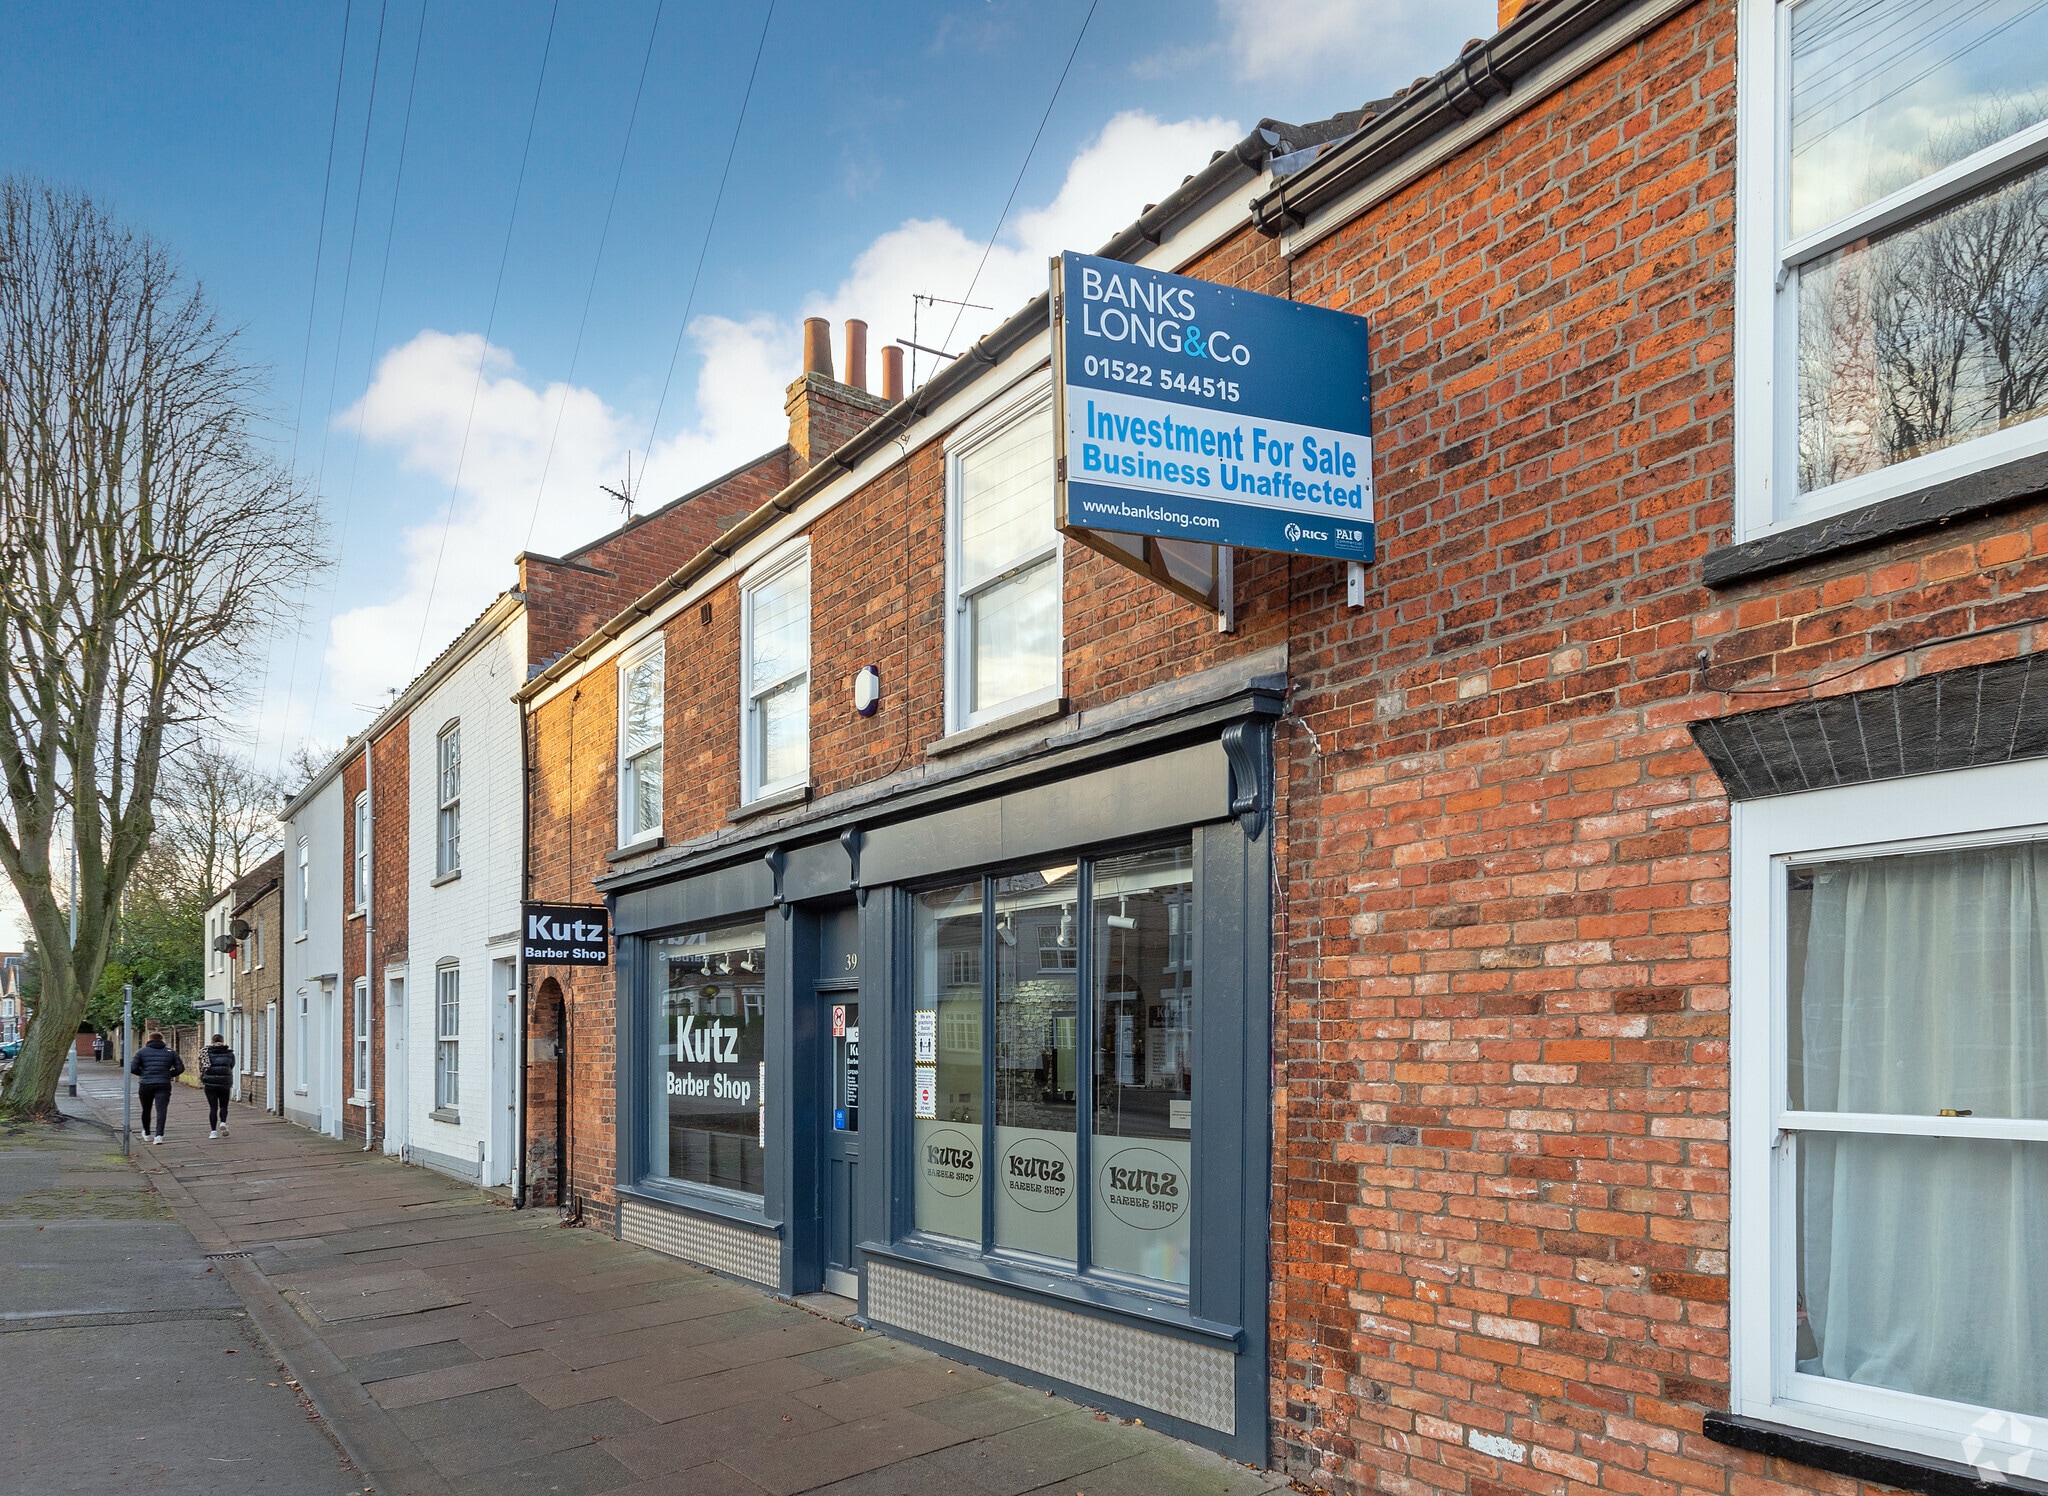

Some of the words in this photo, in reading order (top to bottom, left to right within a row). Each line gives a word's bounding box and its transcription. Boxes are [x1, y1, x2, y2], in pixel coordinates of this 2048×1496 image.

[1083, 267, 1196, 321] BANKS
[1083, 303, 1251, 366] LONG&Co
[1084, 354, 1153, 387] 01522
[1160, 369, 1240, 402] 544515
[1087, 400, 1244, 462] Investment
[1252, 427, 1295, 469] For
[1302, 436, 1356, 478] Sale
[1083, 443, 1211, 487] Business
[1220, 463, 1362, 510] Unaffected
[1083, 500, 1220, 529] www.bankslong.com
[1302, 529, 1328, 541] RICS
[1336, 529, 1352, 541] PAI
[528, 914, 603, 942] Kutz
[525, 947, 569, 958] Barber
[572, 948, 606, 961] Shop
[845, 953, 858, 970] 39
[677, 1015, 738, 1063] Kutz
[667, 1071, 710, 1097] Barber
[713, 1073, 751, 1106] Shop
[927, 1145, 974, 1169] KUTZ
[1009, 1155, 1066, 1182] KUTZ
[928, 1169, 954, 1180] BARBER
[956, 1172, 974, 1182] SHOP
[1009, 1180, 1042, 1193] BARBER
[1044, 1185, 1066, 1196] SHOP
[1109, 1166, 1179, 1197] KUTZ
[1110, 1194, 1150, 1208] BARBER
[1152, 1200, 1178, 1212] SHOP
